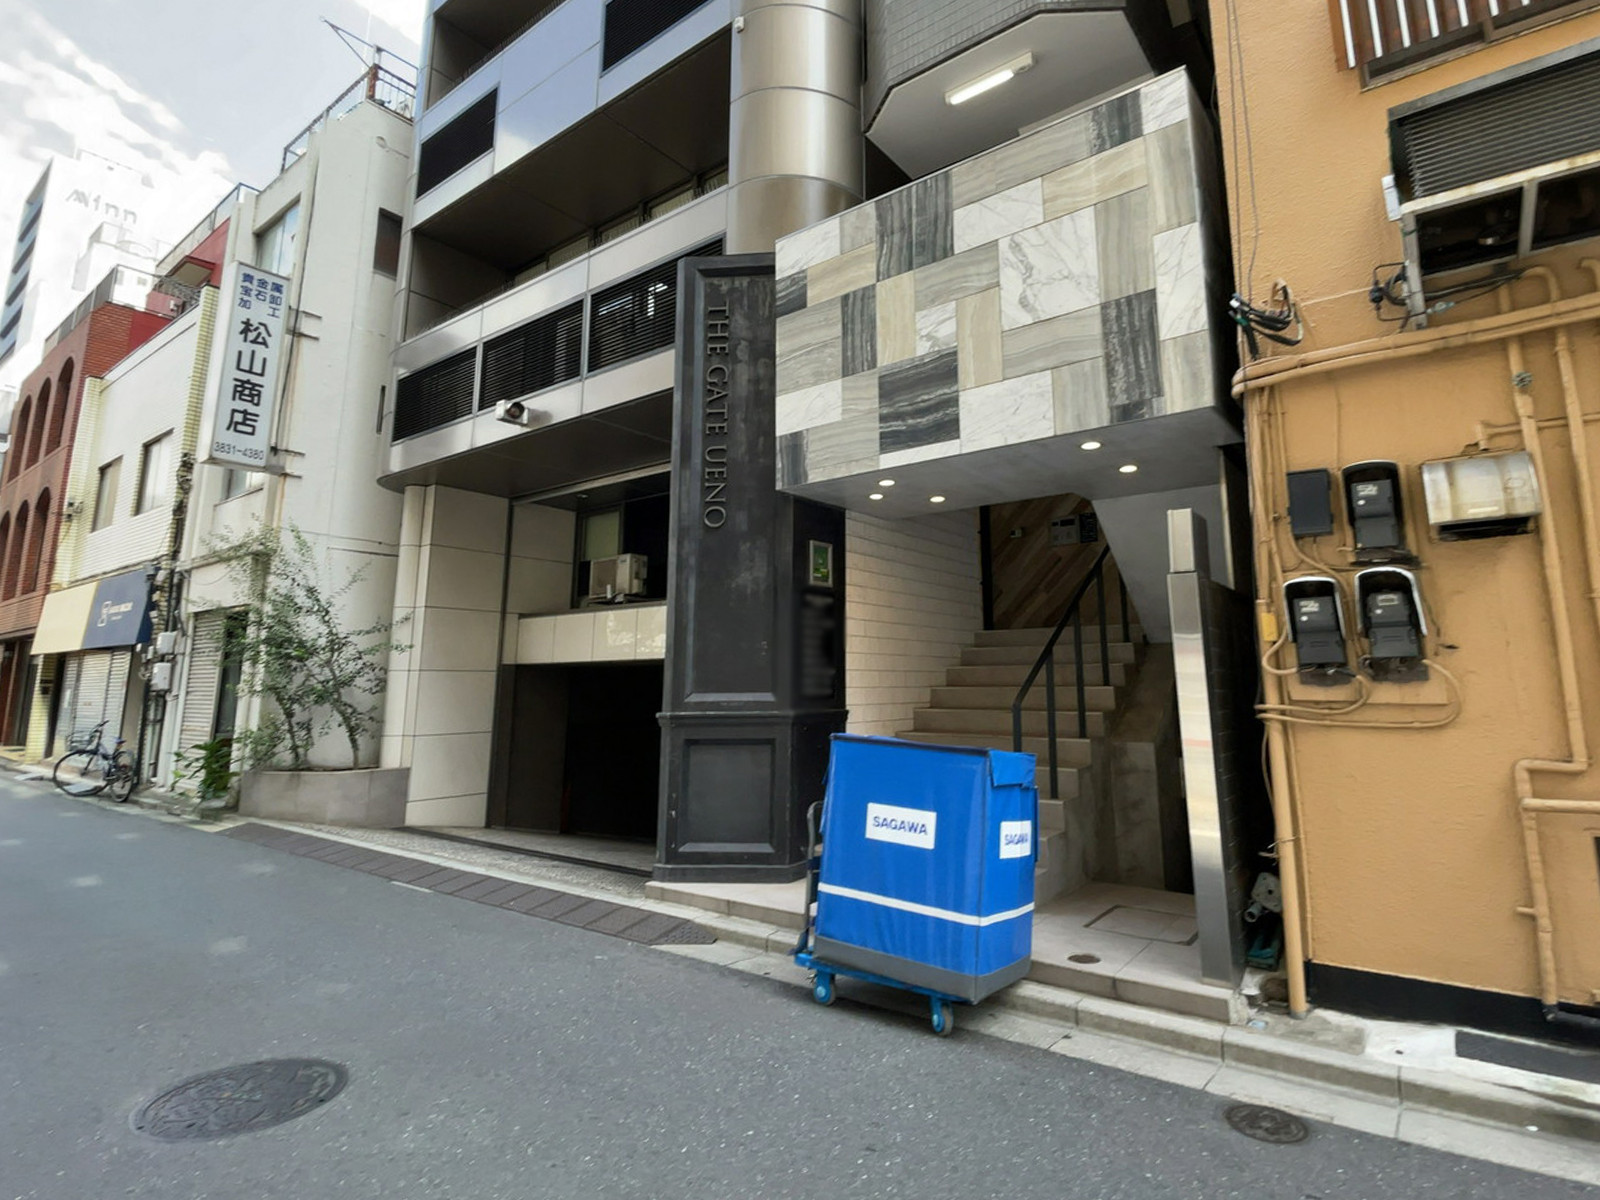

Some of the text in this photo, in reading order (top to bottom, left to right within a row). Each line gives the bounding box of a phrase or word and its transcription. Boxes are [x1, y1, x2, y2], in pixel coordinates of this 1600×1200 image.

[226, 318, 272, 436] 松山商店
[704, 302, 729, 528] THE GATE UENO
[873, 816, 928, 835] SAGAWA
